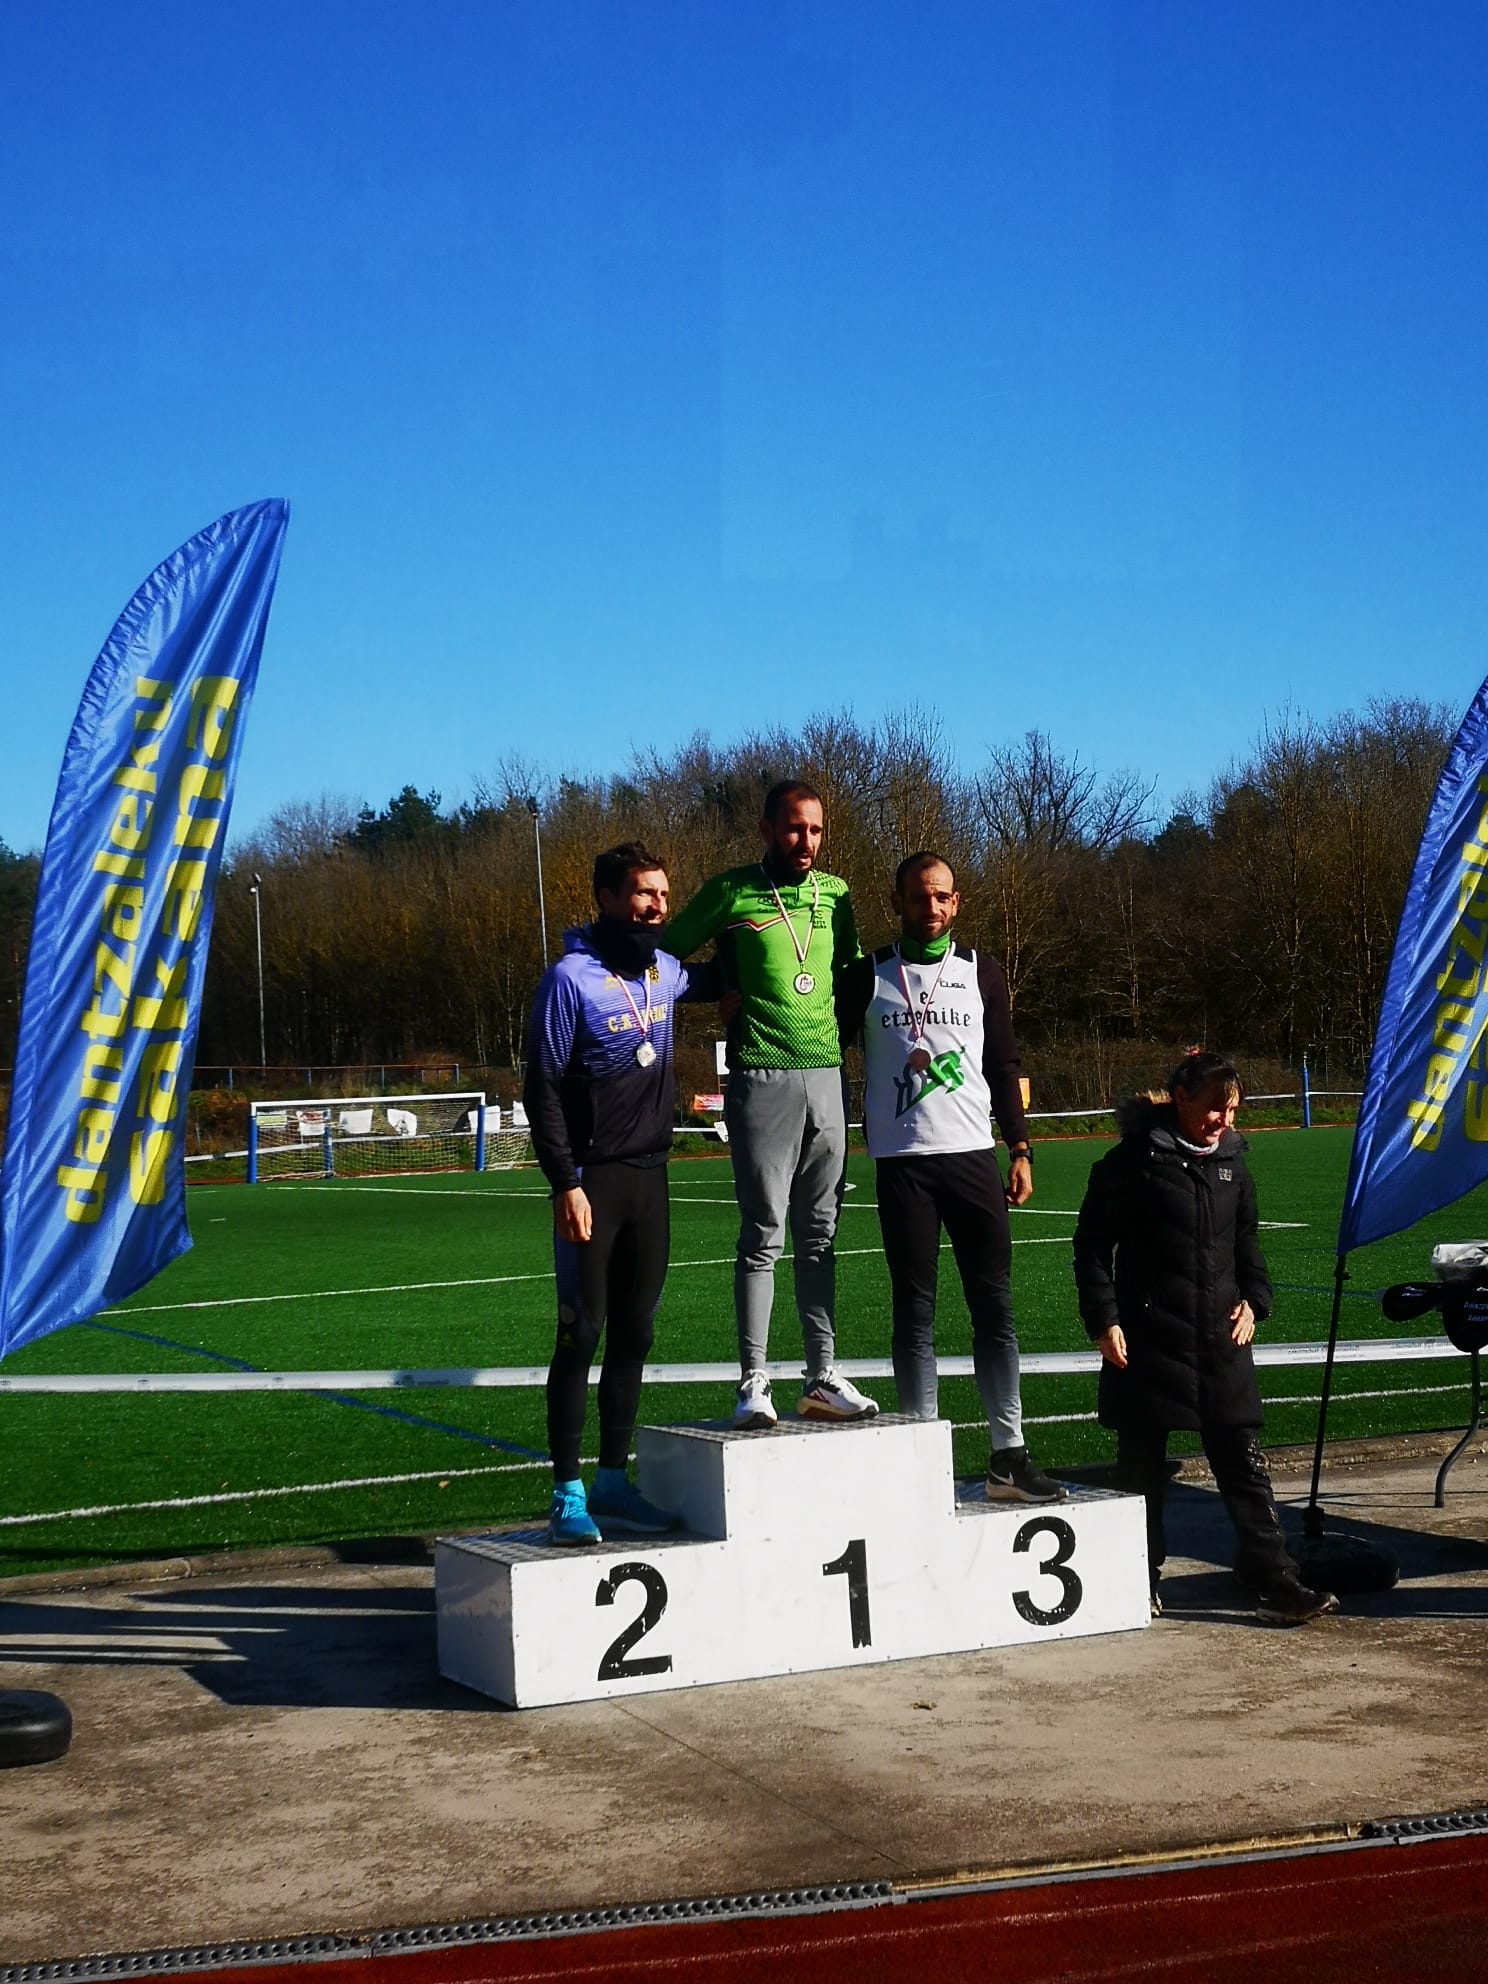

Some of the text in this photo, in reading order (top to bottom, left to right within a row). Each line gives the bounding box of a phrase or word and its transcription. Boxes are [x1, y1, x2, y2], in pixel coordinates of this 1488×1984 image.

[57, 676, 174, 1223] dantzaleku
[128, 675, 240, 1206] sakana
[595, 1561, 674, 1681] 2
[822, 1539, 873, 1649] 1
[1011, 1516, 1083, 1626] 3
